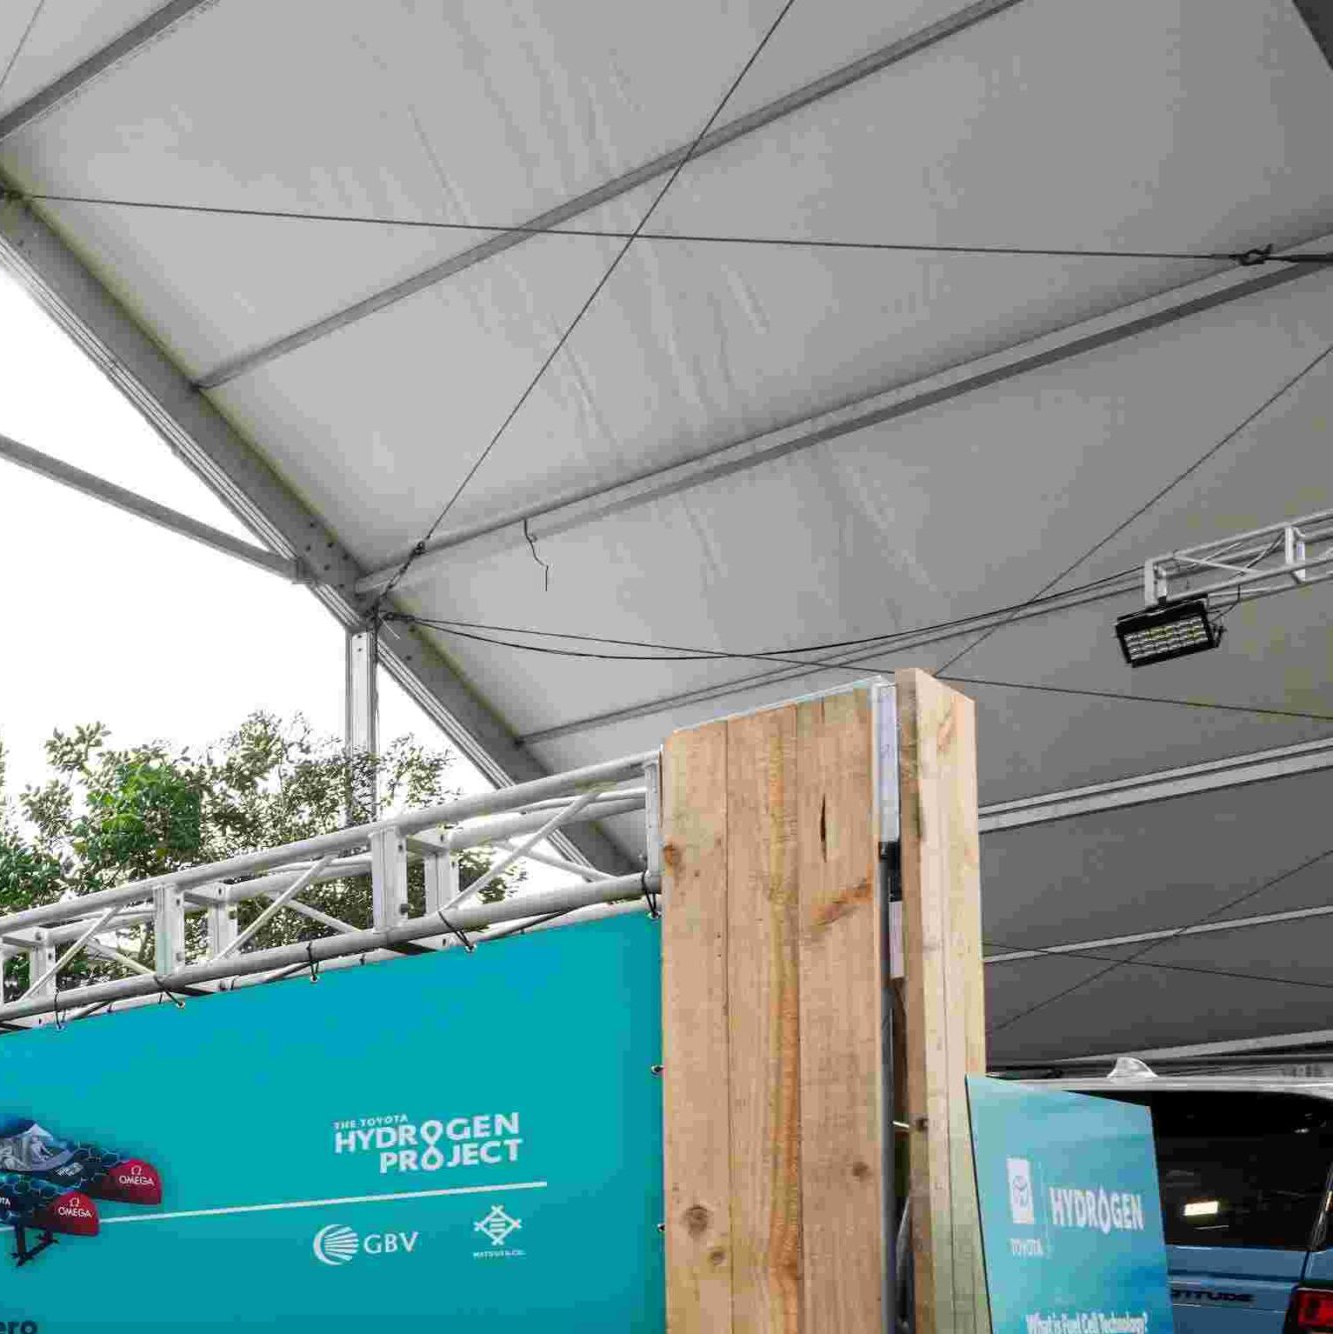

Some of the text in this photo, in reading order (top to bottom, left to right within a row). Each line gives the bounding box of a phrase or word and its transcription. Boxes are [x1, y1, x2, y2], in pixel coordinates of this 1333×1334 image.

[333, 1114, 408, 1130] THE TOYOTA
[334, 1112, 520, 1153] HYDROGEN
[380, 1139, 523, 1174] PROJECT
[119, 1174, 154, 1186] OMEGA
[58, 1207, 93, 1218] OMEGA
[1049, 1185, 1145, 1234] HYDROGEN
[363, 1231, 419, 1254] GBV
